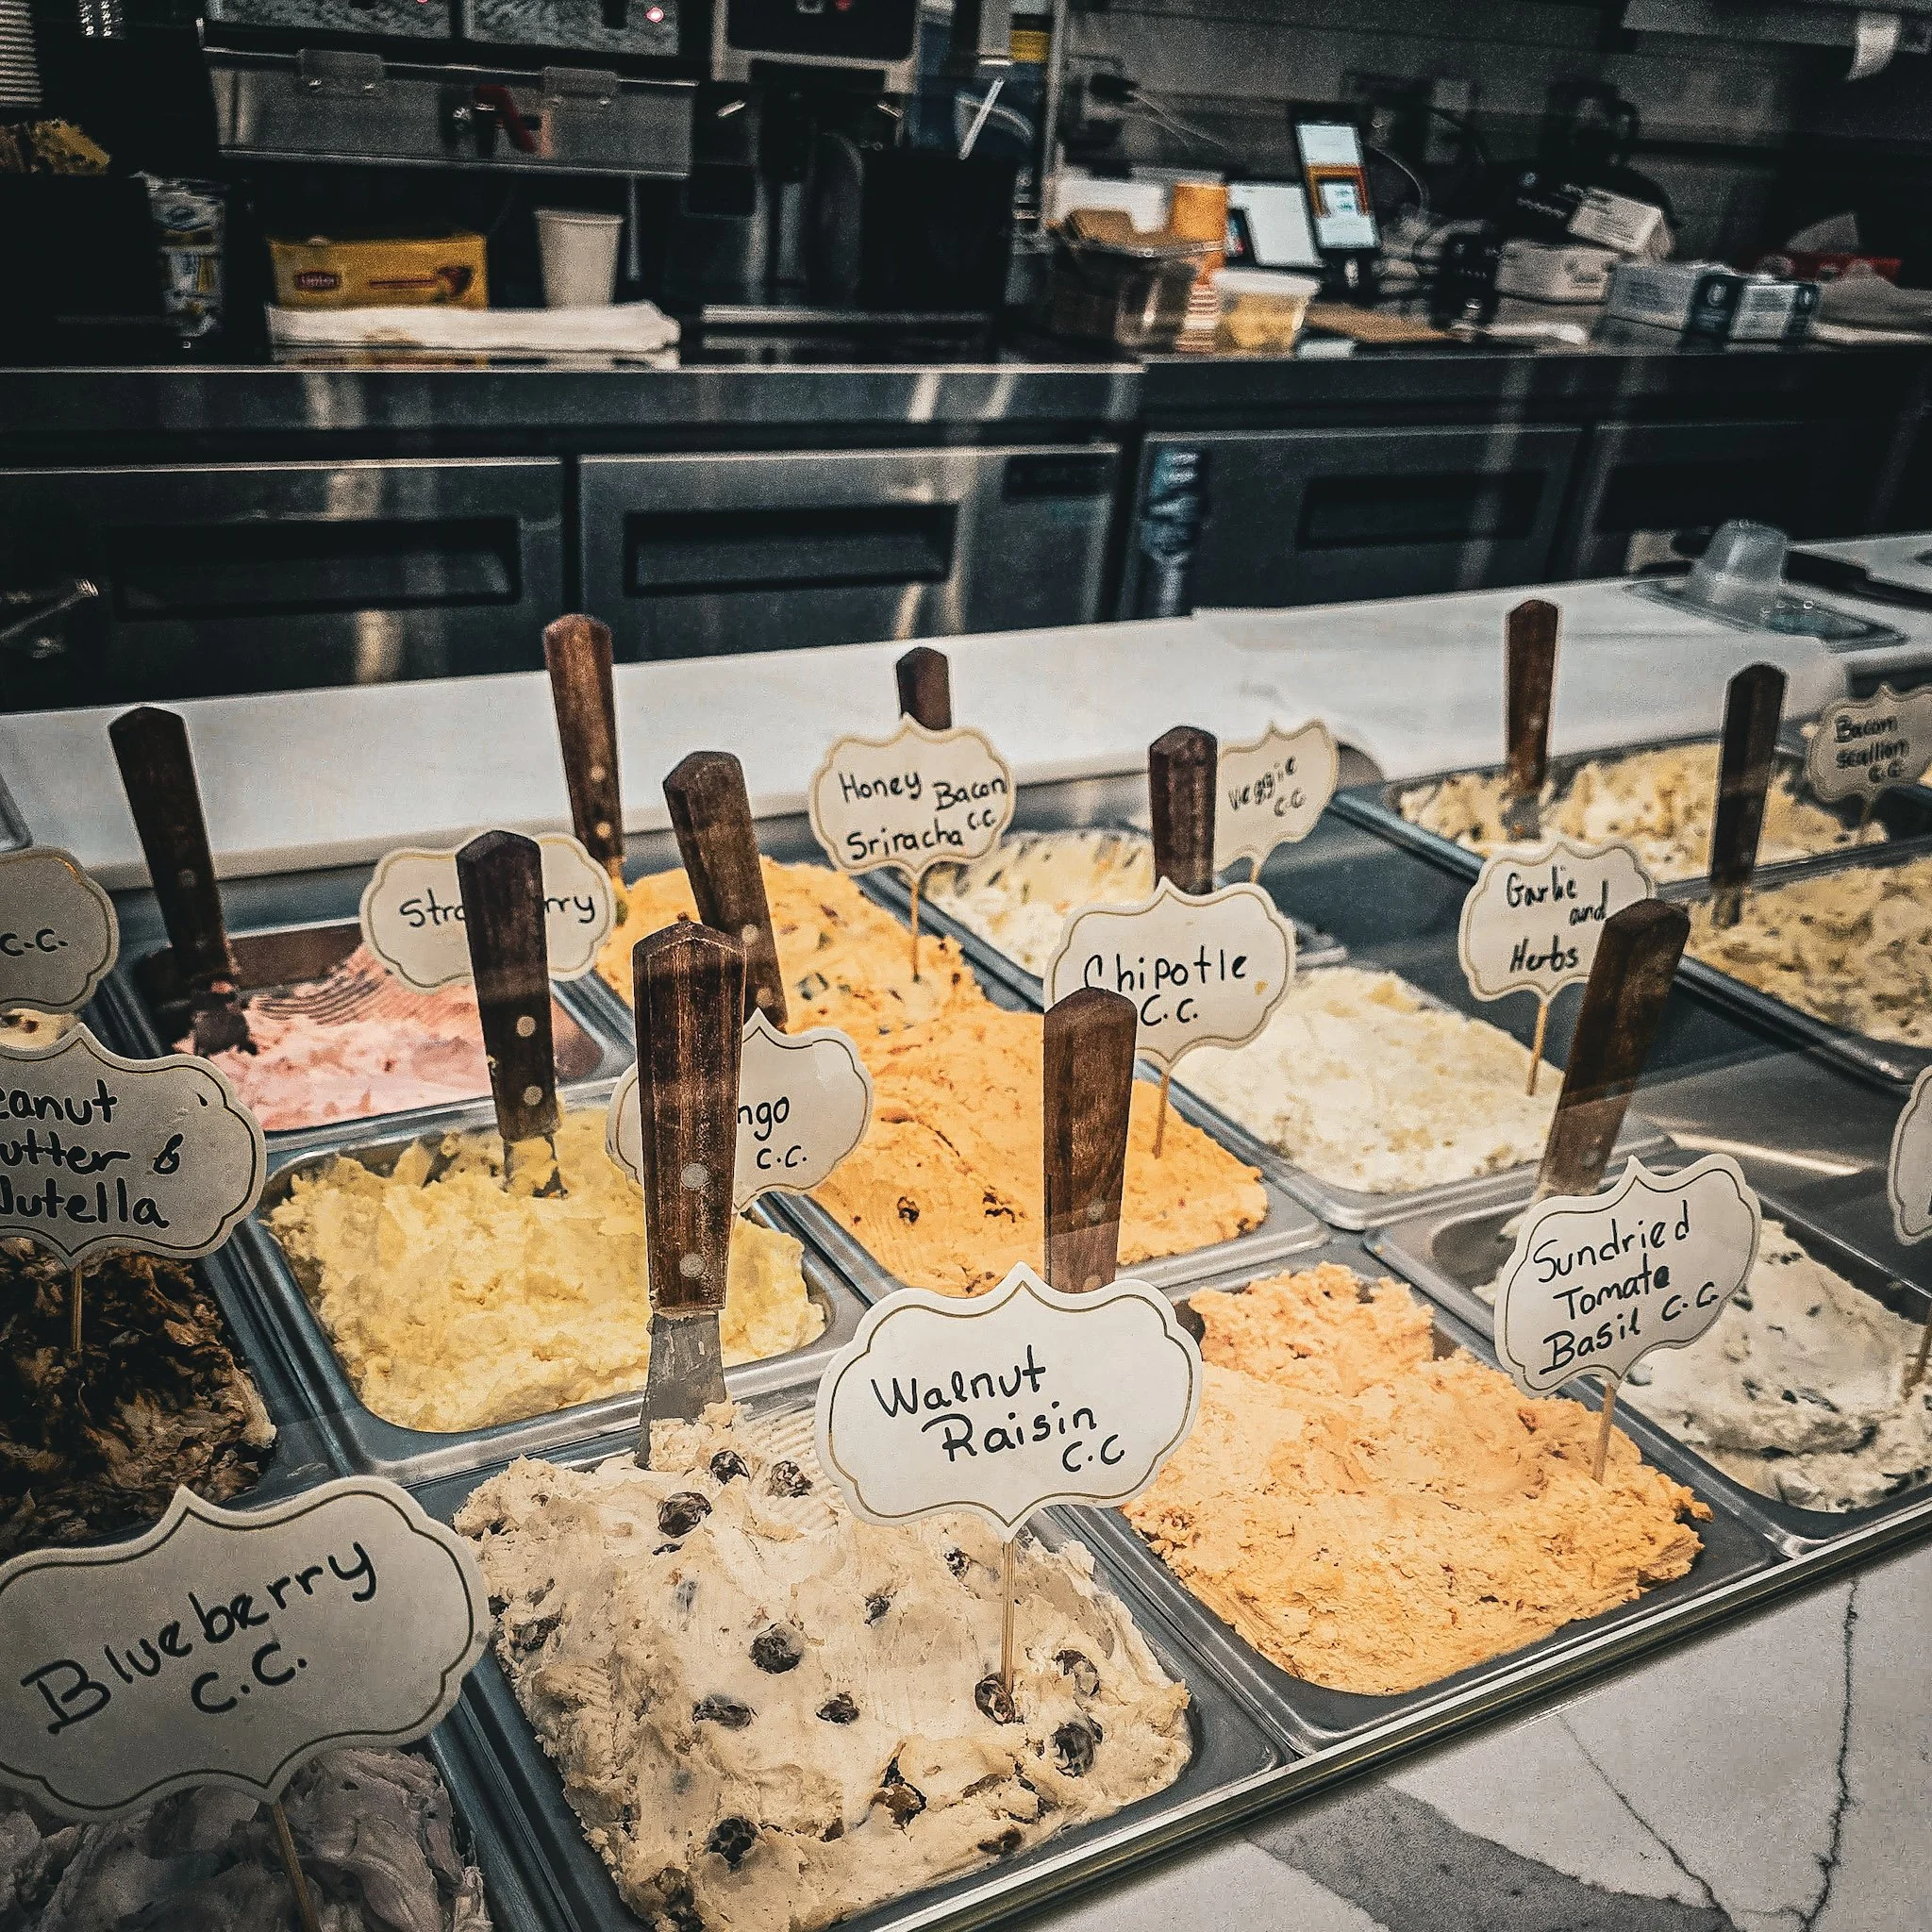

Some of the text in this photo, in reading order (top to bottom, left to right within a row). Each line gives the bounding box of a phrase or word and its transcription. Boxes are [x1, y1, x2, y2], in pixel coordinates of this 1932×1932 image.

[1834, 715, 1898, 743] Bacon
[838, 771, 1008, 812] Honey Bacon
[846, 817, 964, 861] Sriracha
[399, 888, 596, 928] Strarry
[1506, 864, 1579, 908] Garlic
[1569, 878, 1609, 927] and
[1084, 944, 1248, 993] Chipotle
[1508, 933, 1580, 974] Herbs
[737, 1095, 791, 1142] ngo
[0, 1128, 131, 1175] utter
[1532, 1199, 1691, 1284] Sundried
[1538, 1307, 1641, 1375] Basil
[870, 1343, 1047, 1419] Walnut
[921, 1400, 1098, 1462] Raisin
[20, 1540, 378, 1736] Blueberry
